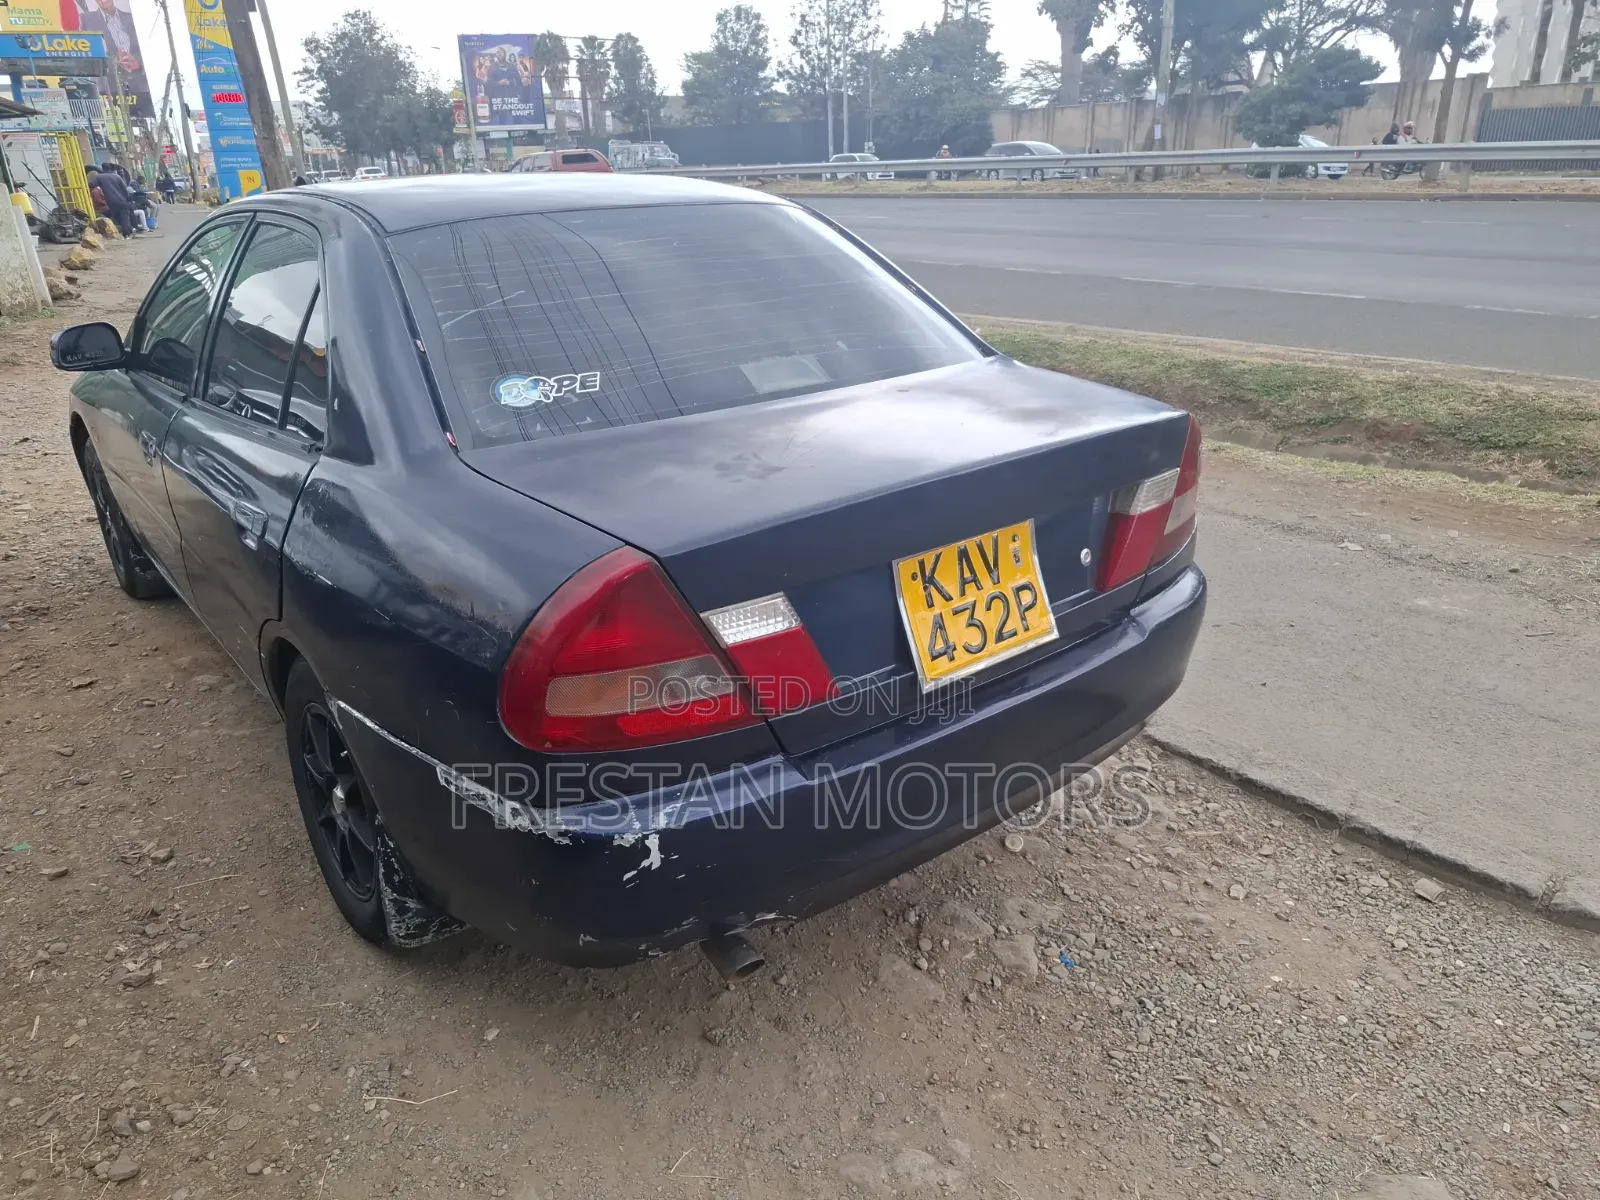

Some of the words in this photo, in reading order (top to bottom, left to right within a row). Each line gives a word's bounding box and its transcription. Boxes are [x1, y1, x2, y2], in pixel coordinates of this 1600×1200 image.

[7, 7, 43, 15] Mama
[42, 34, 91, 52] Lake
[67, 354, 82, 362] KAV
[917, 534, 1001, 609] KAV
[927, 581, 1038, 663] 432P
